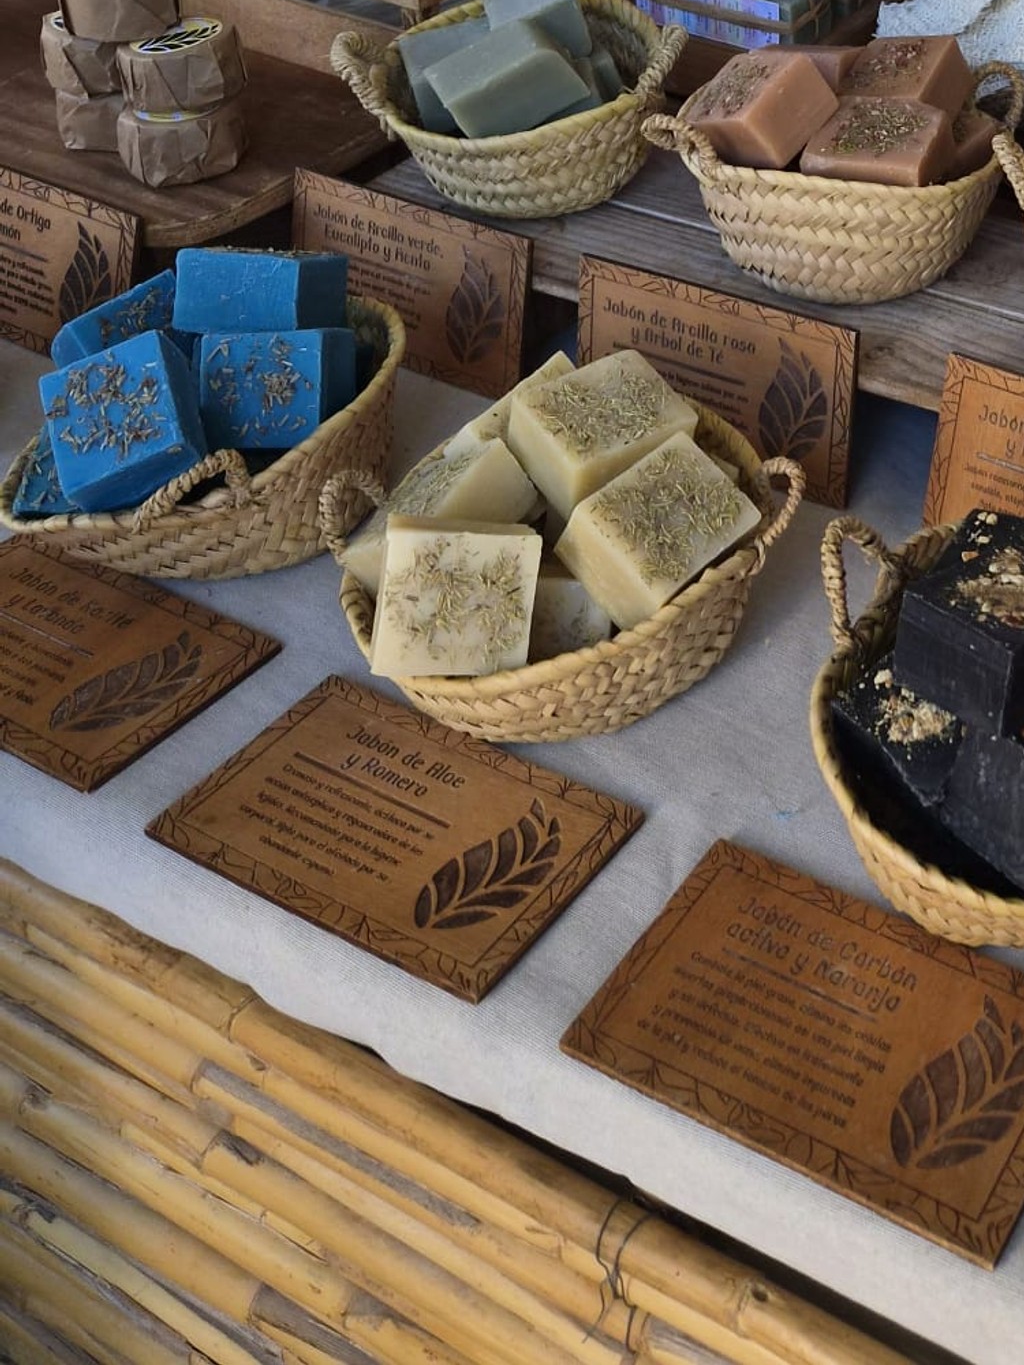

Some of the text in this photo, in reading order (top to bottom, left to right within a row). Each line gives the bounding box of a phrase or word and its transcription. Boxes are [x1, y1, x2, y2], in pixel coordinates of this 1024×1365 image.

[0, 197, 51, 233] de Ortiga
[313, 201, 347, 226] Jabón
[350, 211, 364, 231] de
[367, 218, 404, 244] Arcilla
[324, 222, 379, 259] Eucalipto
[383, 245, 390, 263] y
[603, 294, 756, 355] Jabón de Arcilla rosa
[631, 325, 640, 345] y
[686, 338, 703, 359] de
[1004, 437, 1016, 458] y
[5, 594, 25, 609] y
[9, 568, 57, 596] Jabón
[58, 589, 80, 606] de
[336, 752, 435, 798] y Romero
[343, 723, 472, 789] Jabón de Aloe
[735, 893, 925, 991] Jabón de Carbón
[722, 915, 904, 1020] activo y Naranja
